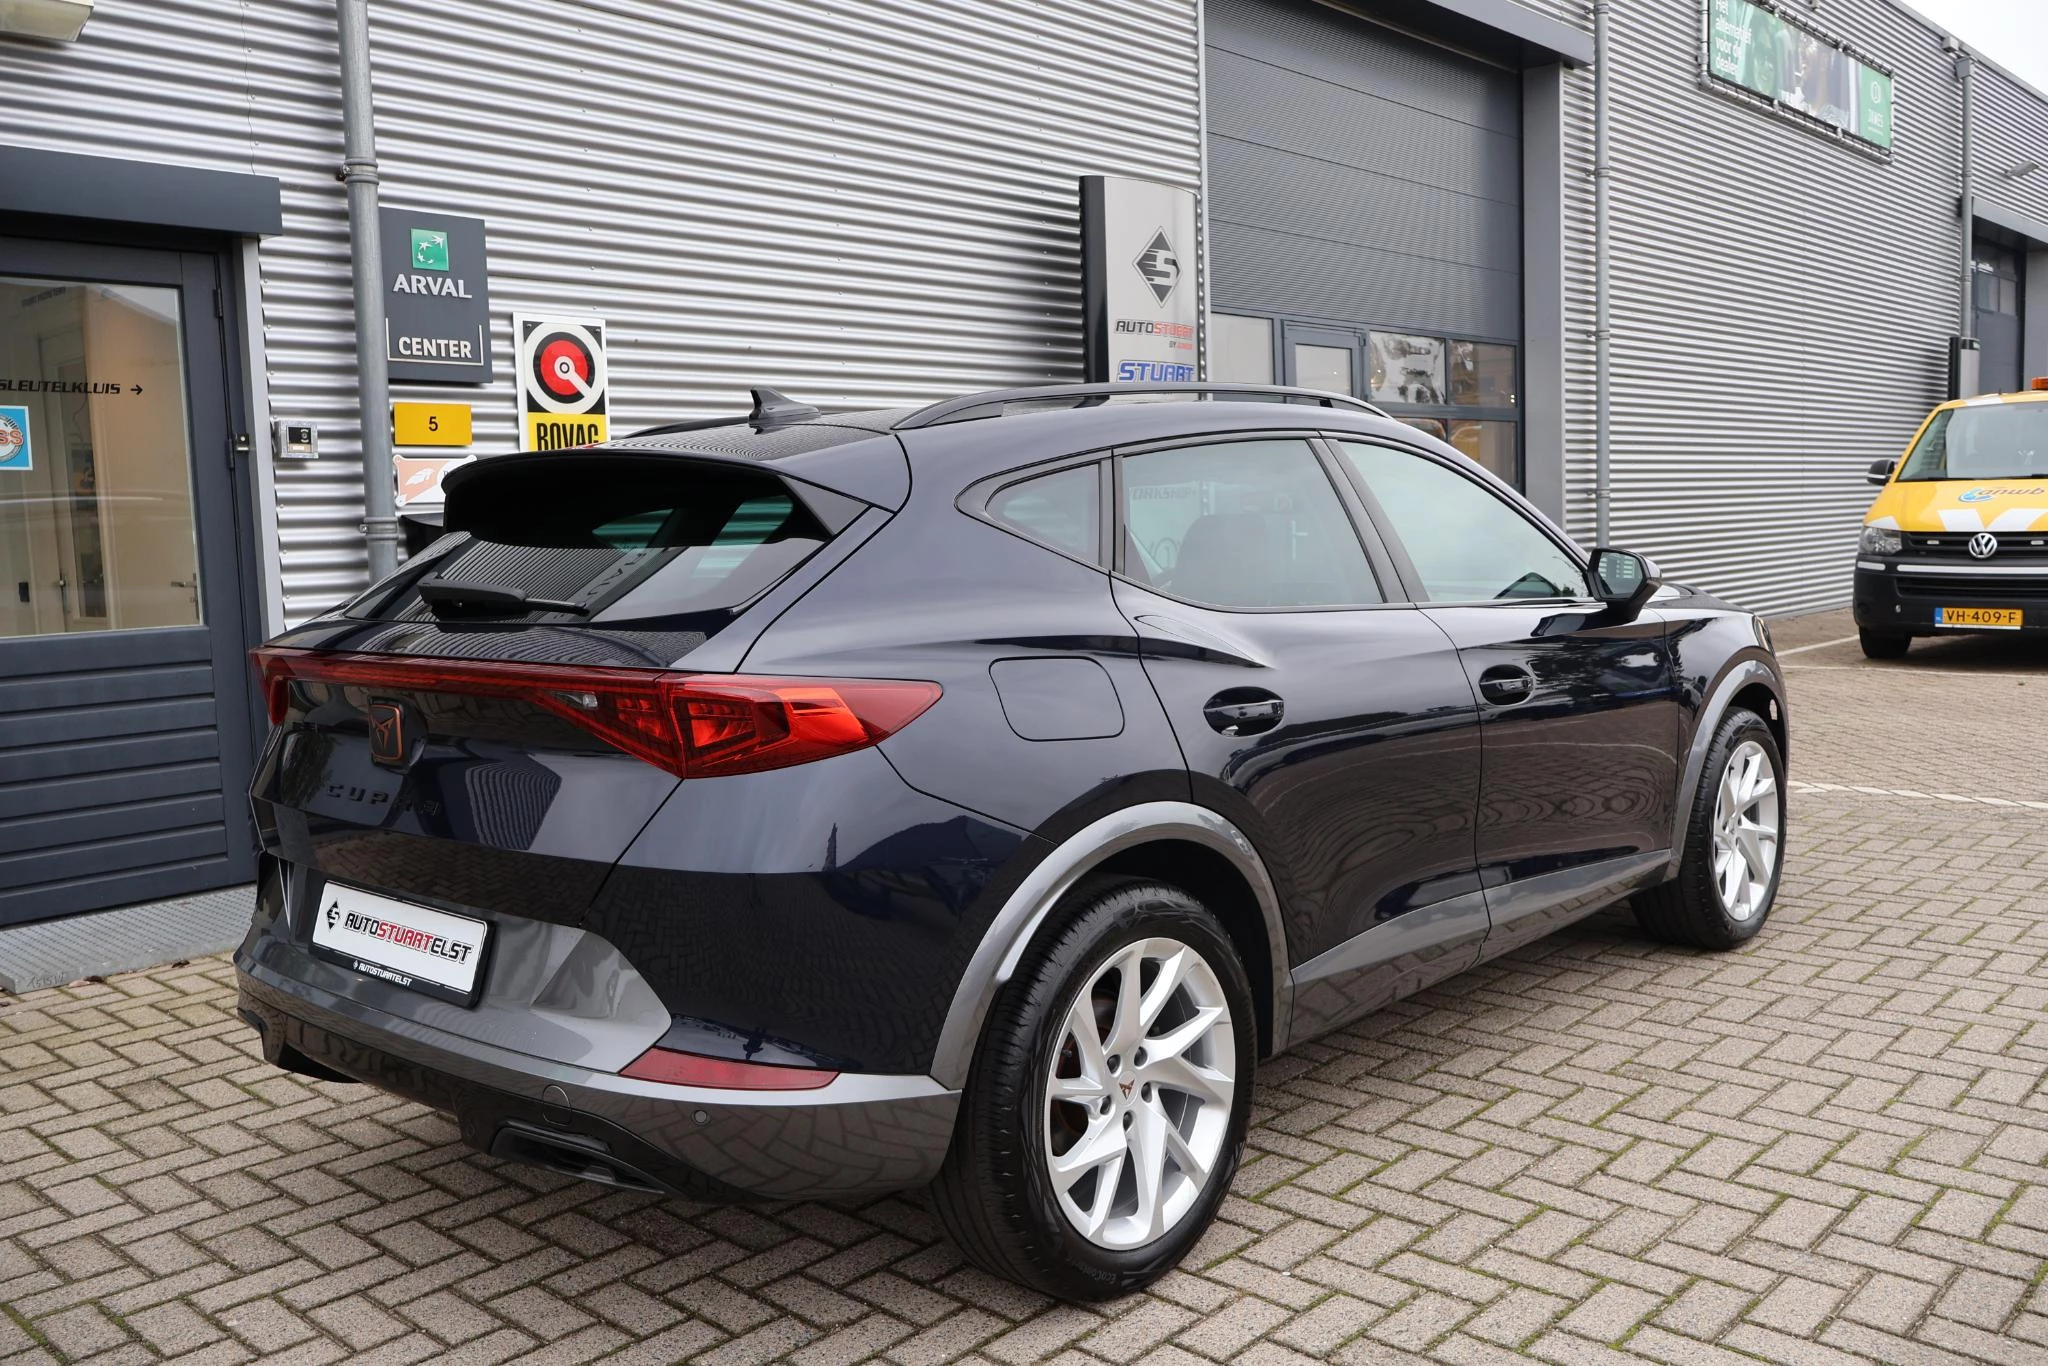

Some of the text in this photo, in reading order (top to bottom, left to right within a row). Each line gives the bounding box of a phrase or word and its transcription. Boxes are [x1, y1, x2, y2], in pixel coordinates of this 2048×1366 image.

[393, 273, 473, 299] ARVAL
[398, 336, 472, 358] CENTER
[1118, 361, 1195, 382] STUART
[428, 416, 439, 432] 5
[1946, 609, 2017, 624] VH-409-F
[344, 912, 473, 963] AUTOSTUARTELST
